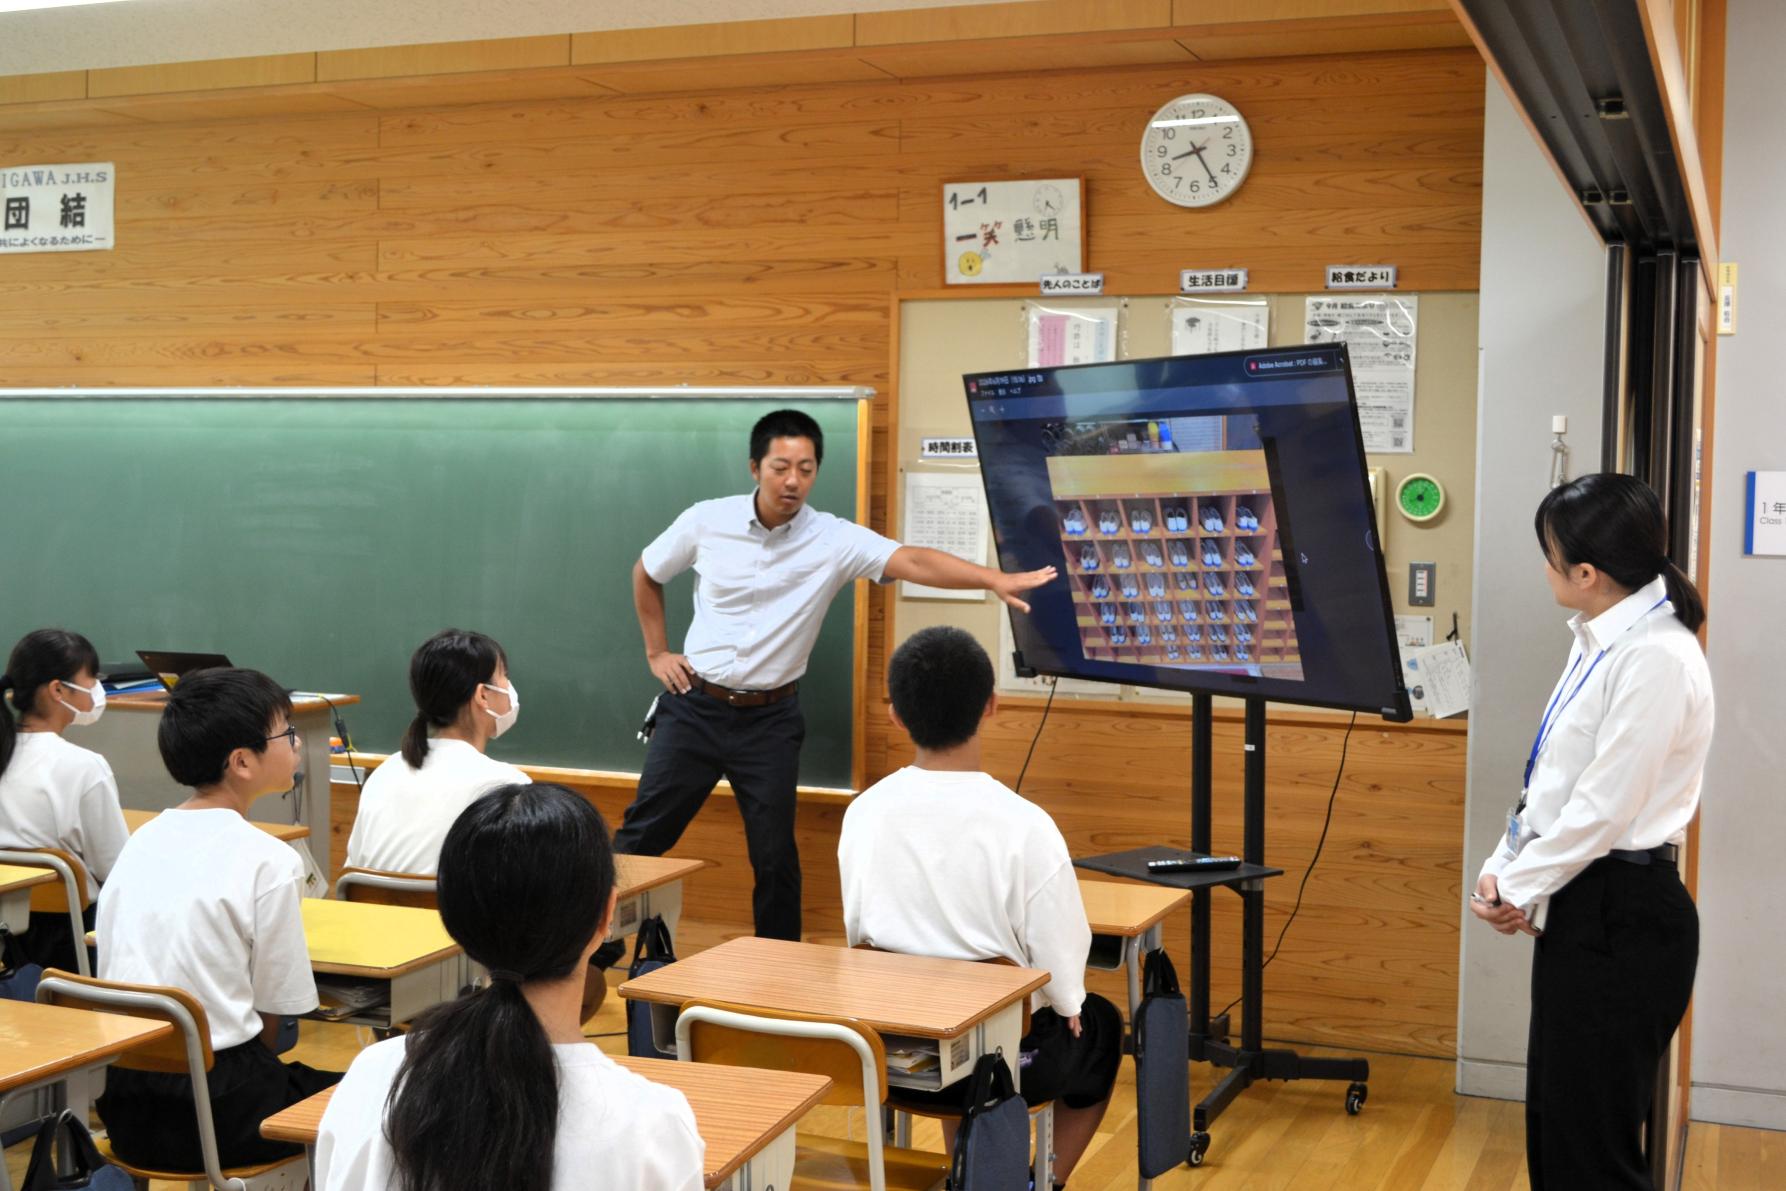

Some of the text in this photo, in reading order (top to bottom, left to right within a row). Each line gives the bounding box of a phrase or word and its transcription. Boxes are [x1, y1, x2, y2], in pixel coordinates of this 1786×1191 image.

[1162, 127, 1176, 140] 10
[1222, 126, 1233, 139] 2
[1157, 145, 1168, 158] 9
[1226, 144, 1237, 157] 3
[1161, 163, 1172, 176] 8
[1220, 163, 1231, 175] 4
[1173, 176, 1183, 189] 7
[1189, 180, 1200, 193] 6
[1331, 271, 1390, 283] 給食だより
[928, 441, 974, 454] 時間割表
